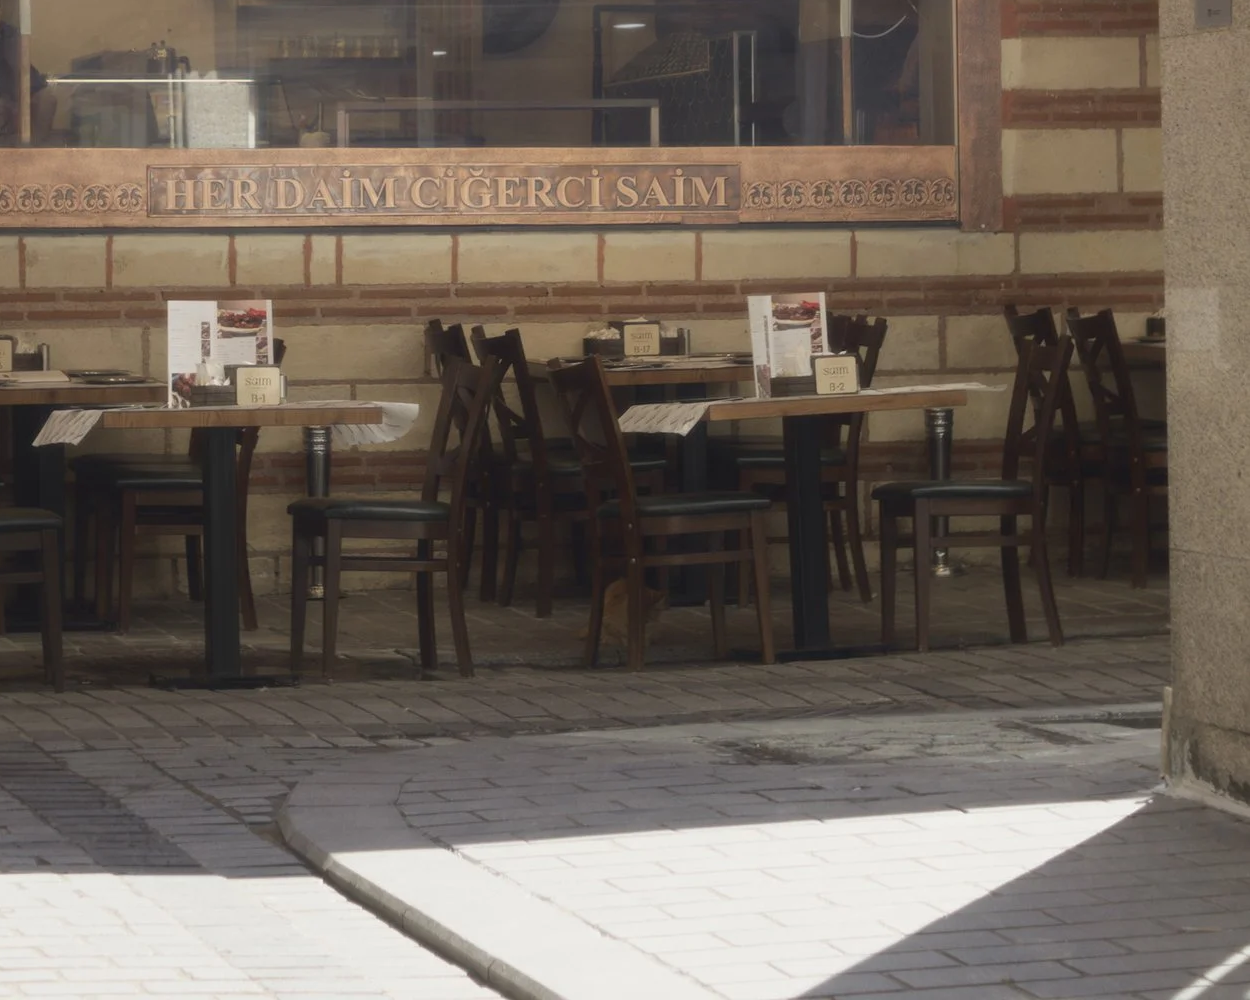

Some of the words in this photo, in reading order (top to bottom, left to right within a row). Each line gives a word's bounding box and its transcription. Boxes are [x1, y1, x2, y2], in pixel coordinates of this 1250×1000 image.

[165, 176, 262, 210] HER
[273, 169, 397, 209] DAİM
[411, 167, 602, 209] CİĞERCİ
[616, 167, 727, 208] SAİM
